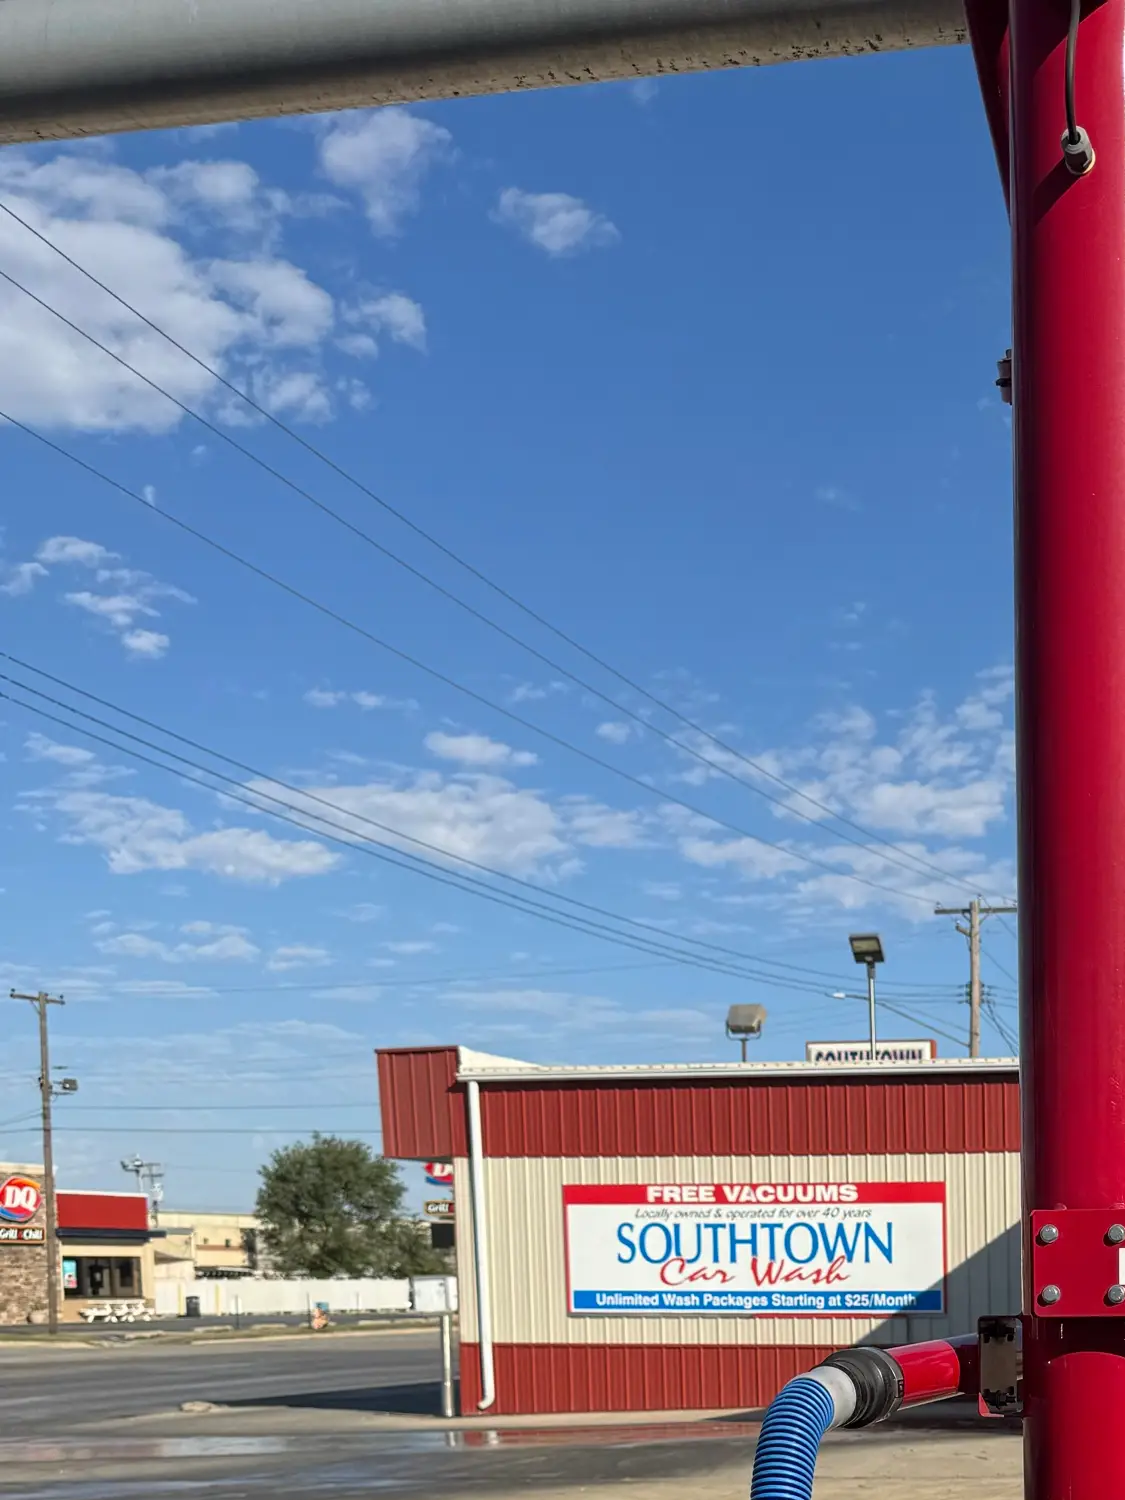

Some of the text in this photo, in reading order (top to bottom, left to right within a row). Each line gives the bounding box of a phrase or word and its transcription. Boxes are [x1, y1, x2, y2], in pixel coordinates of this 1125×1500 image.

[5, 1185, 37, 1211] DQ
[646, 1184, 859, 1203] FREE VACUUMS
[634, 1207, 873, 1221] Locally owned & operated for over 40 years
[616, 1221, 894, 1265] SOUTHTOWN
[659, 1254, 852, 1288] Car Wash
[595, 1292, 918, 1309] Unlimited Wash Packages Starting at $25/Month
